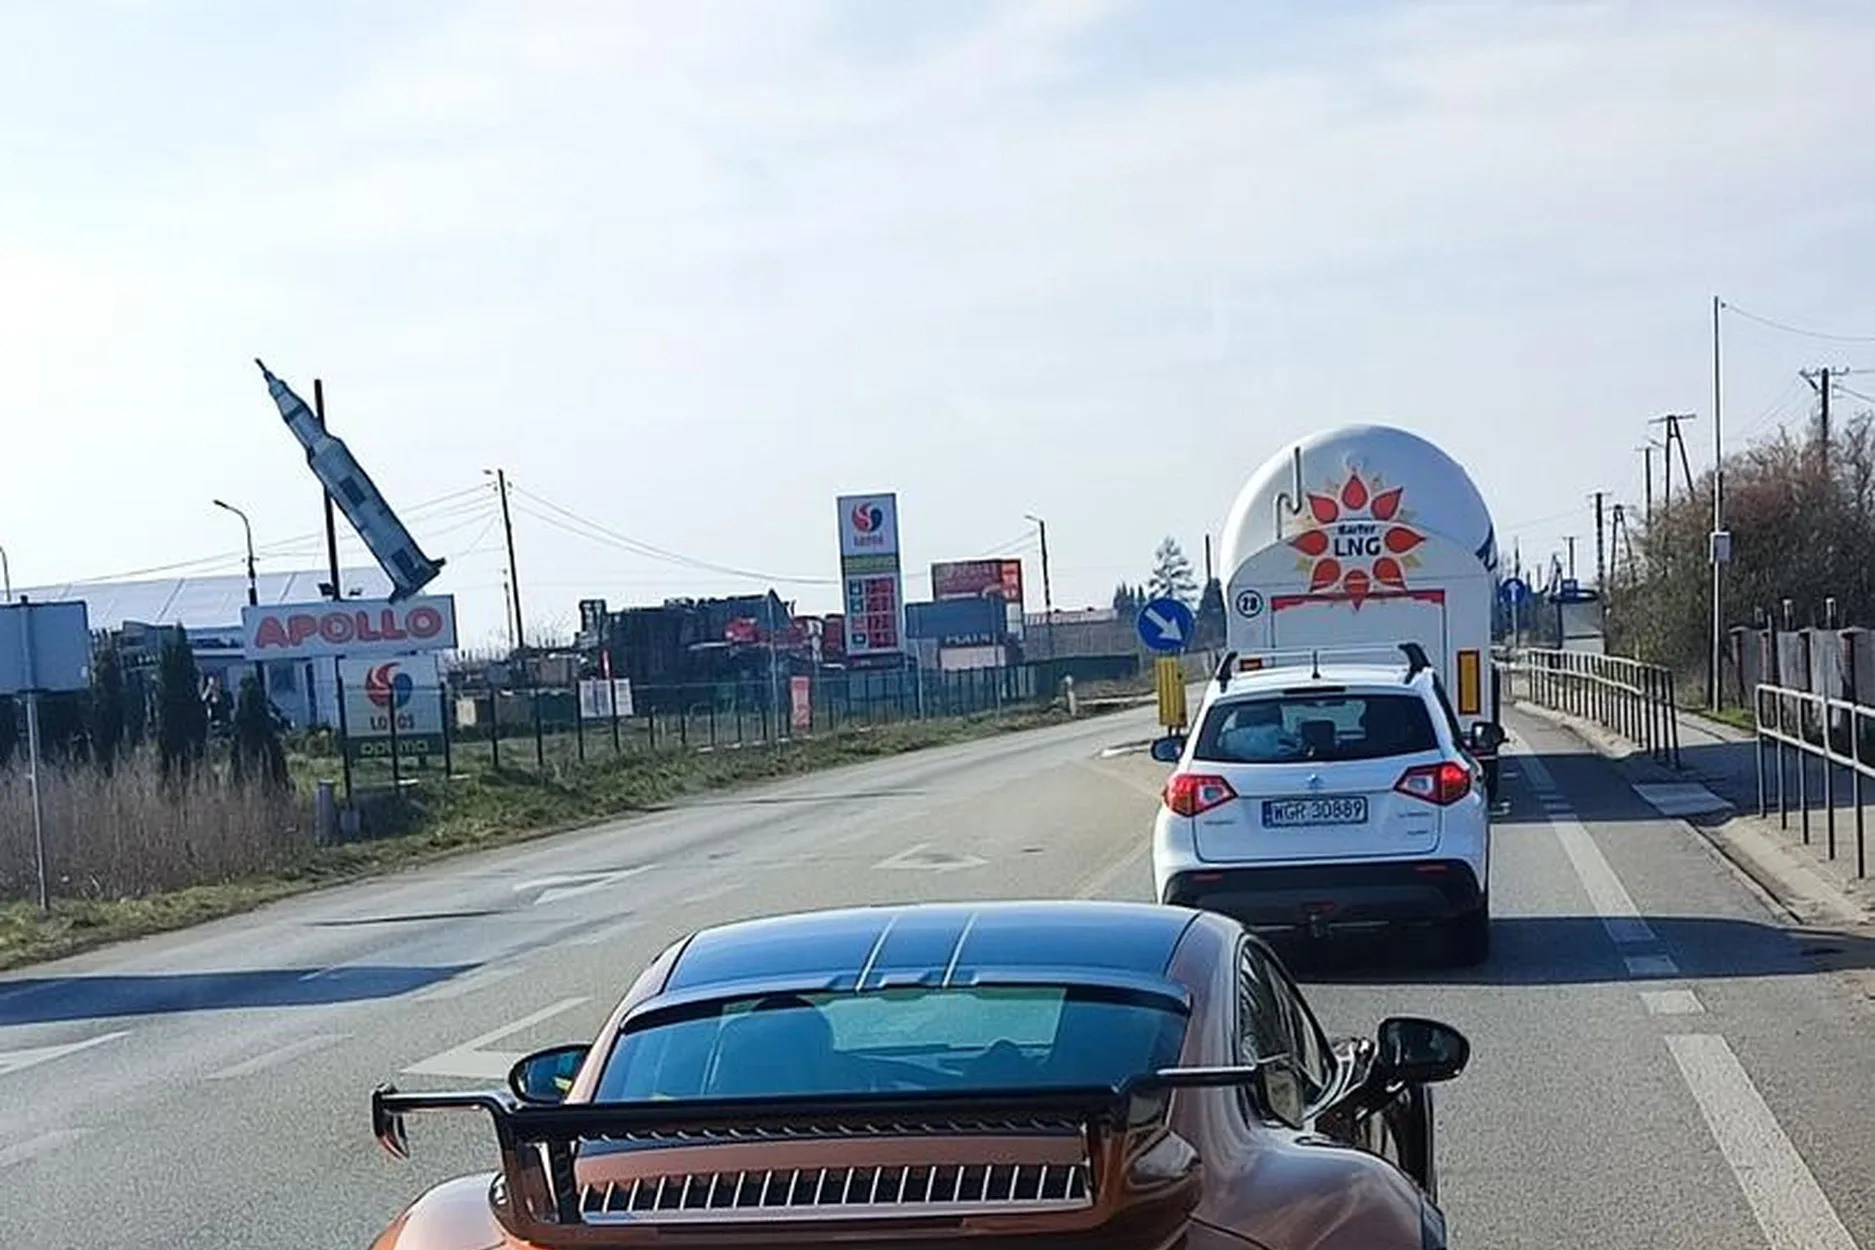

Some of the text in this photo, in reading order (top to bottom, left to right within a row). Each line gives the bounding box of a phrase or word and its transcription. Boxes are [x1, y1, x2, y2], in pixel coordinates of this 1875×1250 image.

[1334, 536, 1381, 557] LNG
[1242, 597, 1258, 611] 28
[256, 605, 443, 649] APOLLO
[1311, 800, 1362, 819] 30889
